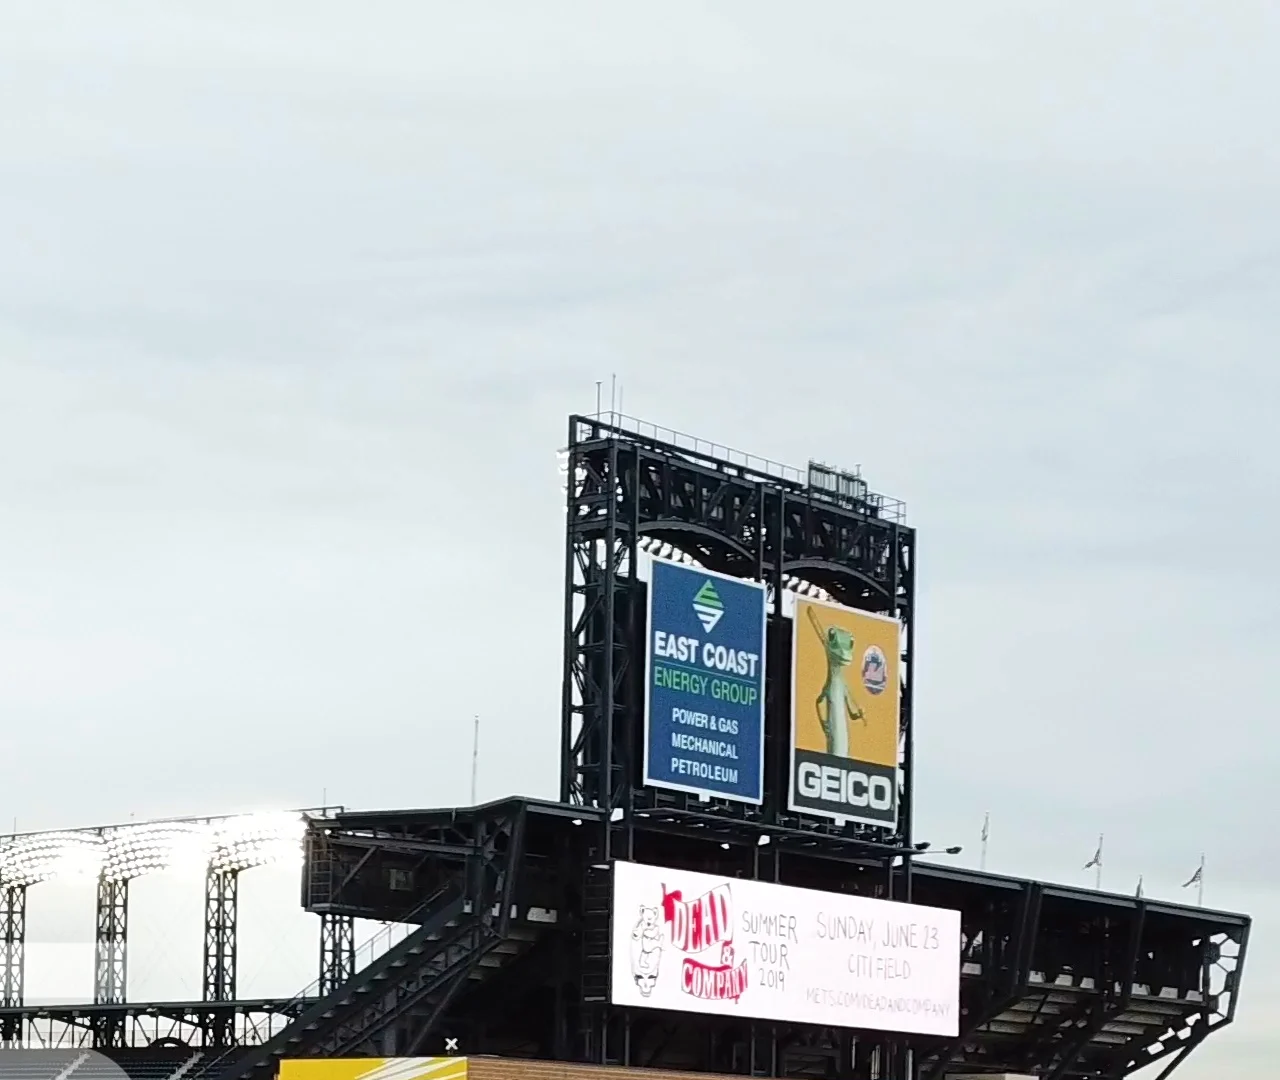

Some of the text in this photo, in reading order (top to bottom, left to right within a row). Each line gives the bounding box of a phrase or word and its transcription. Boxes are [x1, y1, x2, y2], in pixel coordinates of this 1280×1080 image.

[654, 631, 759, 678] EAST COAST
[653, 665, 758, 706] ENERGY GROUP
[672, 708, 739, 735] POWER & GAS
[671, 733, 739, 760] MECHANICAL
[671, 757, 738, 785] PETROLEUM
[797, 761, 891, 812] GEICO
[742, 911, 798, 945] SUMMER
[816, 911, 939, 950] SUNDAY, JUNE 23
[719, 943, 735, 966] &
[748, 940, 790, 971] TOUR
[848, 953, 912, 981] CITI FIELD
[759, 968, 786, 991] 2019
